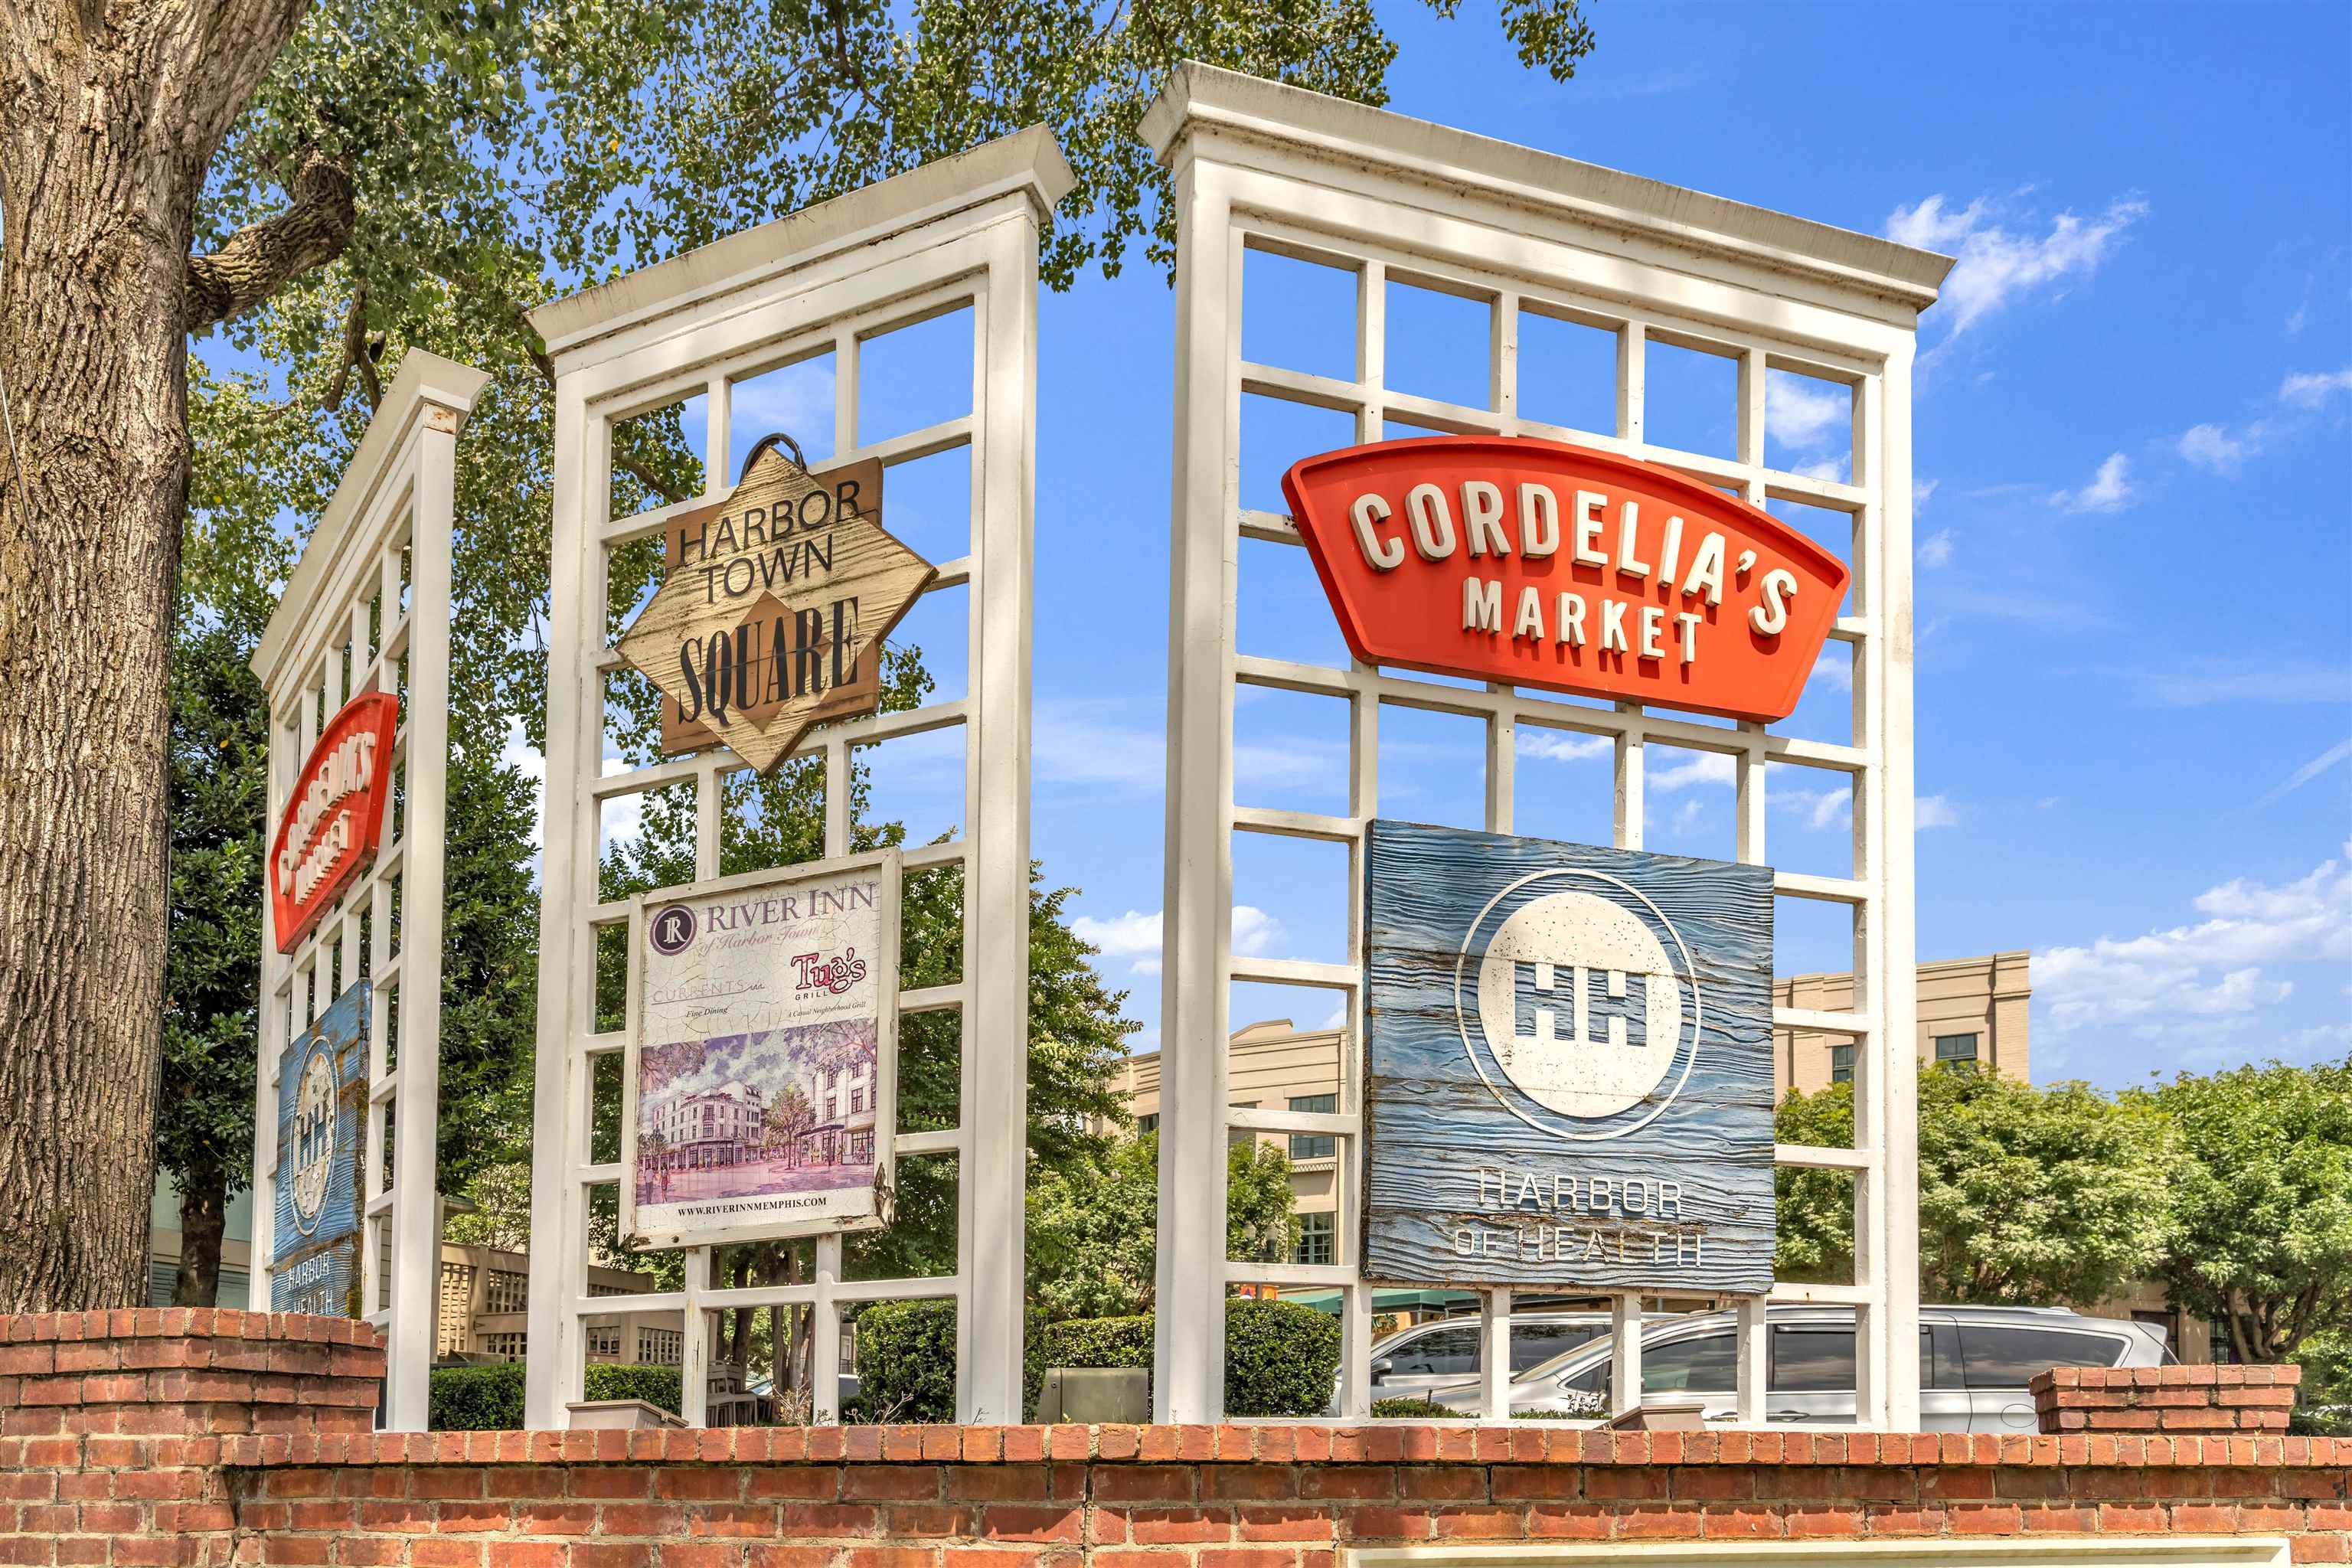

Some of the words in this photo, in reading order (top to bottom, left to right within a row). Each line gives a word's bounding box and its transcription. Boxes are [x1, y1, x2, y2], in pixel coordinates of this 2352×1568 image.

[680, 479, 861, 566] HARBOR
[698, 533, 833, 604] TOWN
[1348, 480, 1798, 637] CORDELIA'S
[1462, 576, 1702, 665] MARKET
[678, 596, 860, 727] SQUARE
[706, 896, 801, 933] RIVER
[808, 884, 875, 916] INN
[700, 937, 718, 956] of
[717, 930, 773, 950] Harbor
[778, 924, 818, 942] Town
[652, 978, 745, 1003] CURRENTS
[790, 946, 867, 995] Tug's
[686, 1009, 703, 1018] Fine
[704, 1006, 729, 1017] Dining
[792, 1008, 812, 1018] Casual
[812, 1004, 851, 1016] Neighborhood
[851, 1000, 867, 1009] Grill
[795, 990, 828, 1001] GRILL
[1514, 960, 1648, 1047] HH
[678, 1197, 828, 1217] WWW.RIVERINNMEMPHIS.COM
[1479, 1168, 1682, 1214] HARBOR
[1454, 1228, 1500, 1256] OF
[1517, 1225, 1702, 1268] HEALTH
[288, 1251, 330, 1291] HARBOR
[294, 1289, 332, 1315] HEALTH
